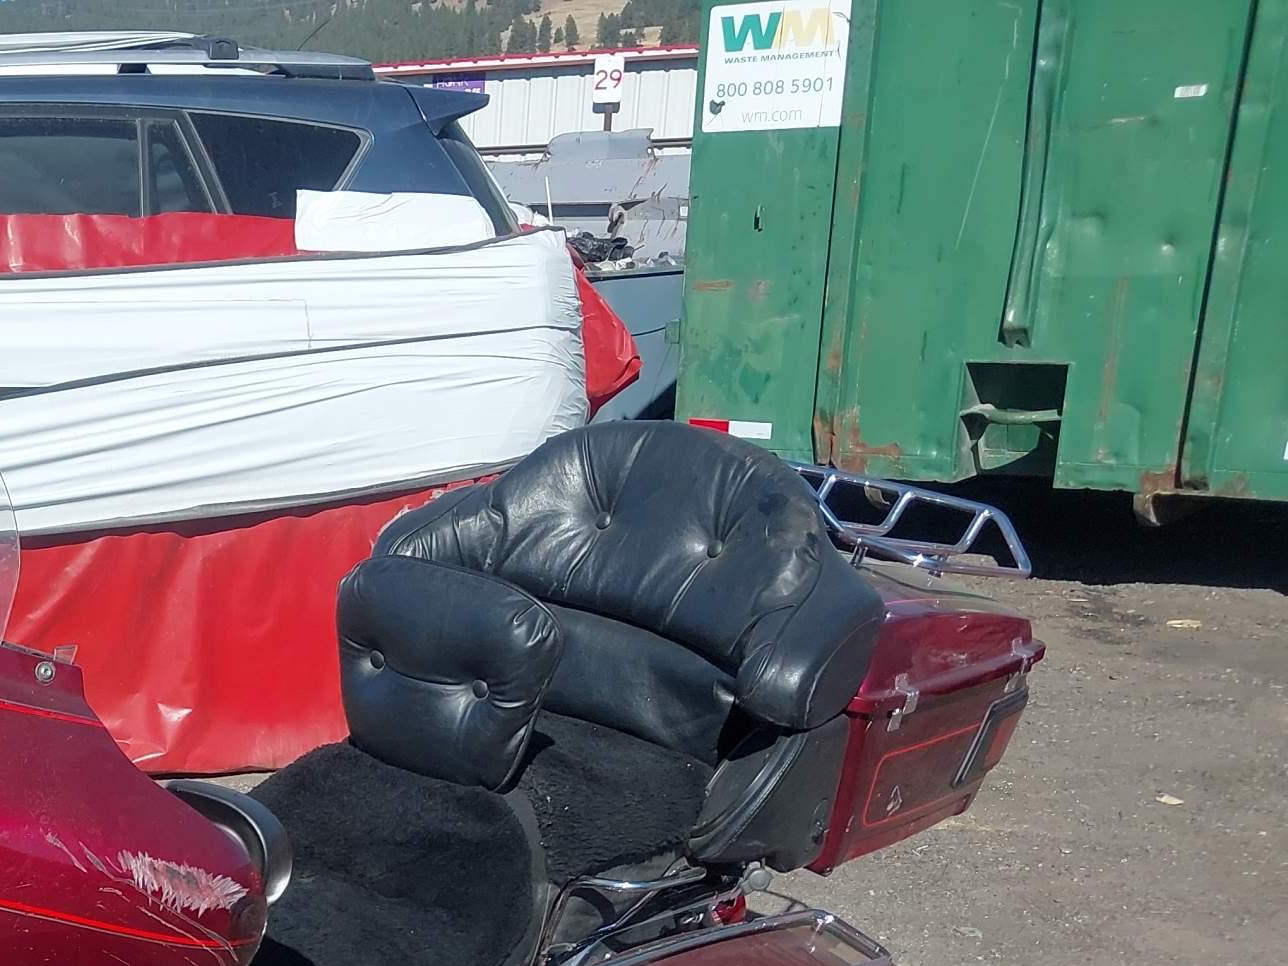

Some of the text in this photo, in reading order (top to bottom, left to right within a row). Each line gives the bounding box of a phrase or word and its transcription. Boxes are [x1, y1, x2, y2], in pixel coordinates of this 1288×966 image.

[721, 8, 835, 52] WM
[724, 50, 834, 65] WASTE MANAGEMENT
[595, 69, 622, 90] 29
[716, 77, 834, 98] 800 808 5901
[741, 109, 803, 123] wm.com
